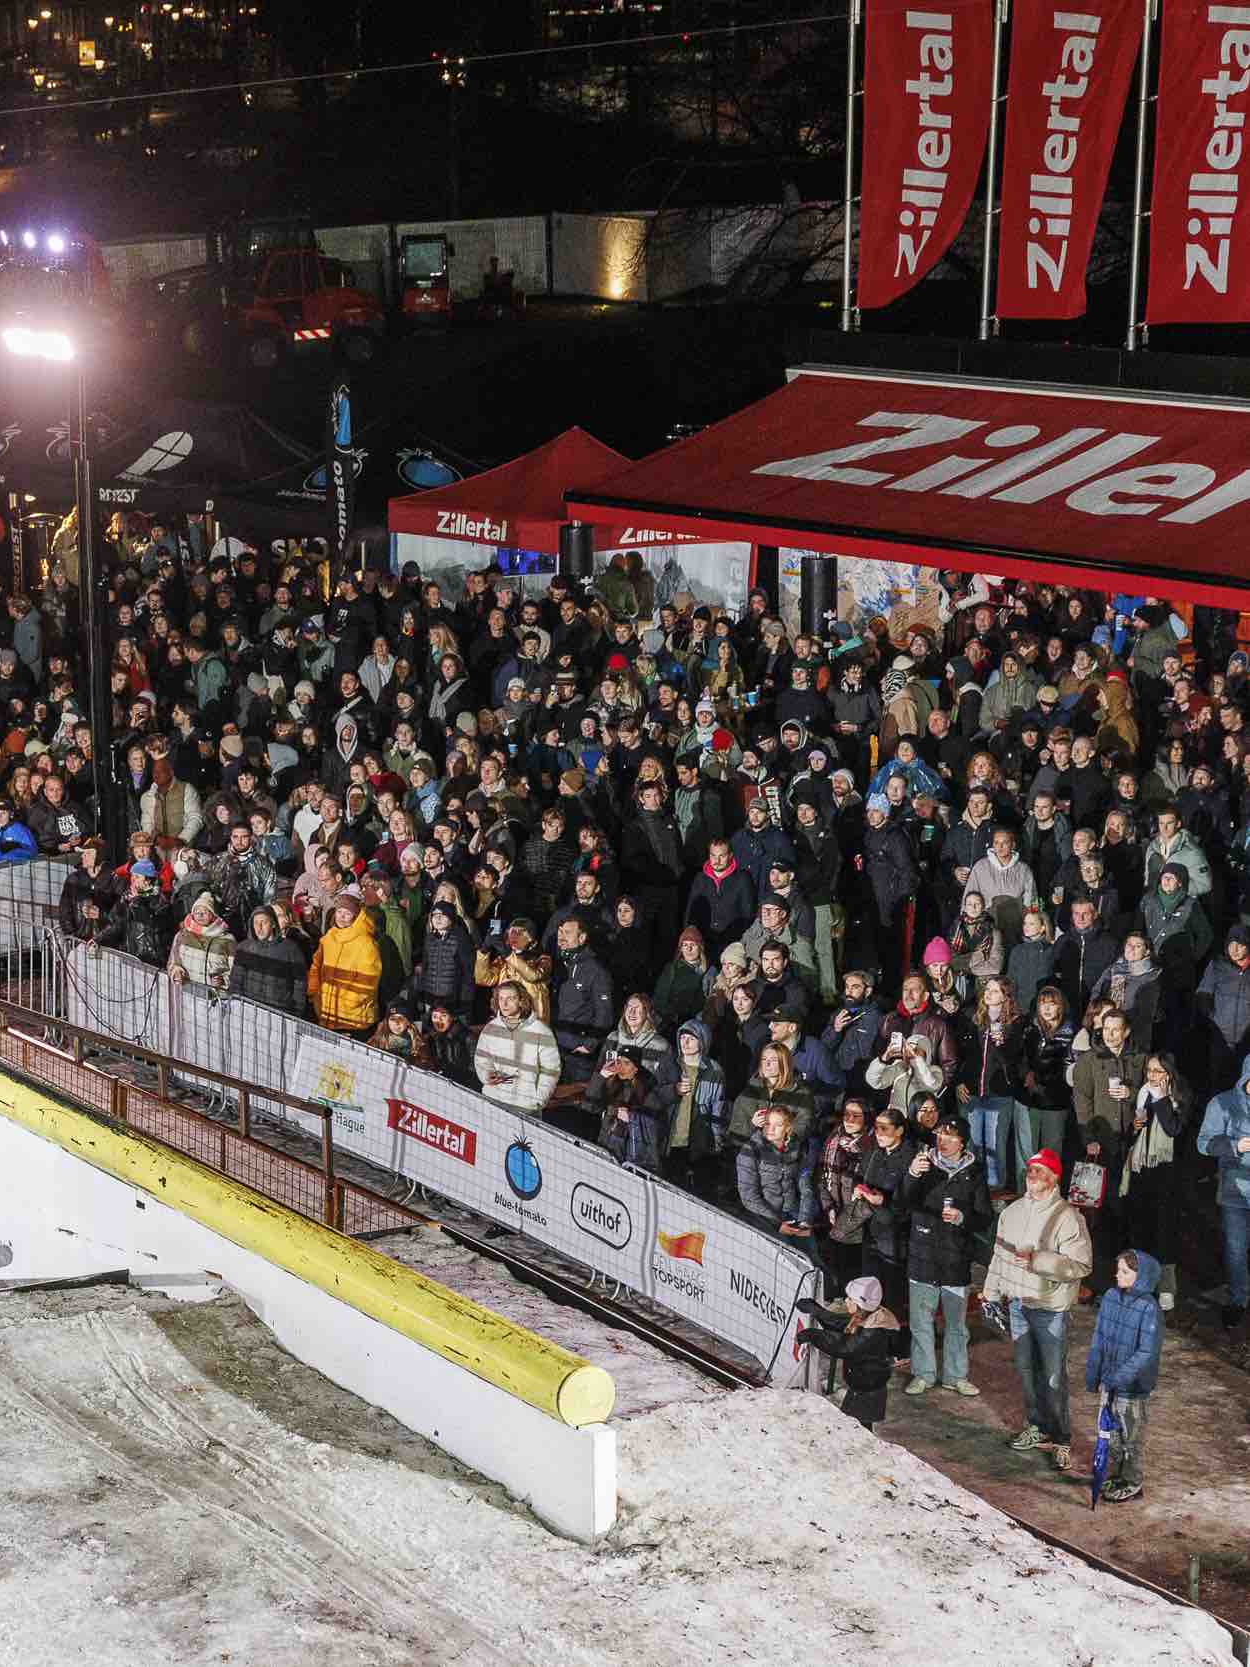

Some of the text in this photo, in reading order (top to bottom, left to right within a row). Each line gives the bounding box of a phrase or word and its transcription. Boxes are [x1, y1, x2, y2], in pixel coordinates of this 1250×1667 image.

[893, 11, 953, 278] Zillertal
[1026, 12, 1102, 292] Zillertal
[1183, 6, 1250, 294] Zillertal
[436, 511, 508, 542] Zillertal
[334, 1110, 366, 1135] Hague
[398, 1104, 466, 1156] Zillertal
[494, 1191, 548, 1227] blue-tomato
[580, 1199, 622, 1233] uithof
[651, 1266, 705, 1303] TOPSPORT
[730, 1268, 786, 1328] NIDECKER
